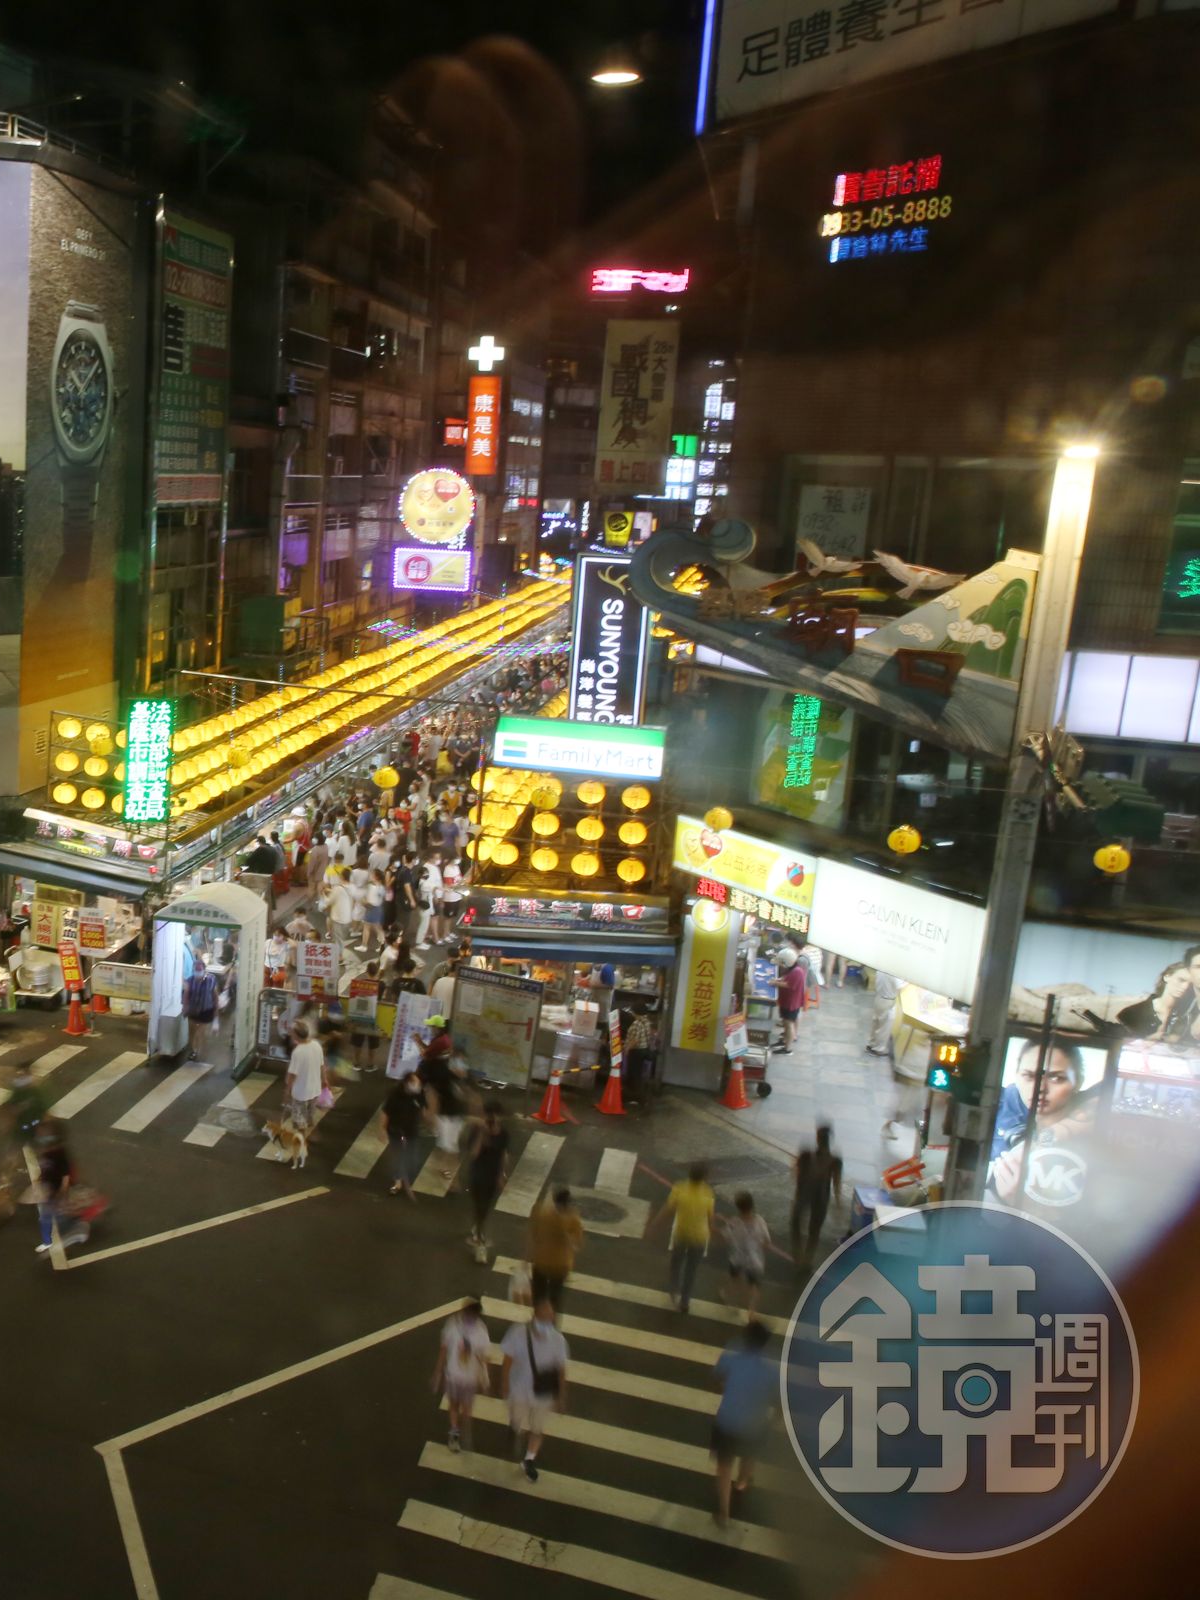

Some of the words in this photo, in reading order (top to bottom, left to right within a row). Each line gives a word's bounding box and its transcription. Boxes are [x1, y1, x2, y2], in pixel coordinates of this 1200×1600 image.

[471, 395, 495, 457] 康是美
[537, 742, 655, 770] FamilyMart
[857, 898, 908, 929] CALVIN
[909, 916, 950, 945] KLEIN
[305, 945, 332, 957] 紙本
[687, 959, 718, 1042] 公益彩券
[1027, 1159, 1084, 1194] MK
